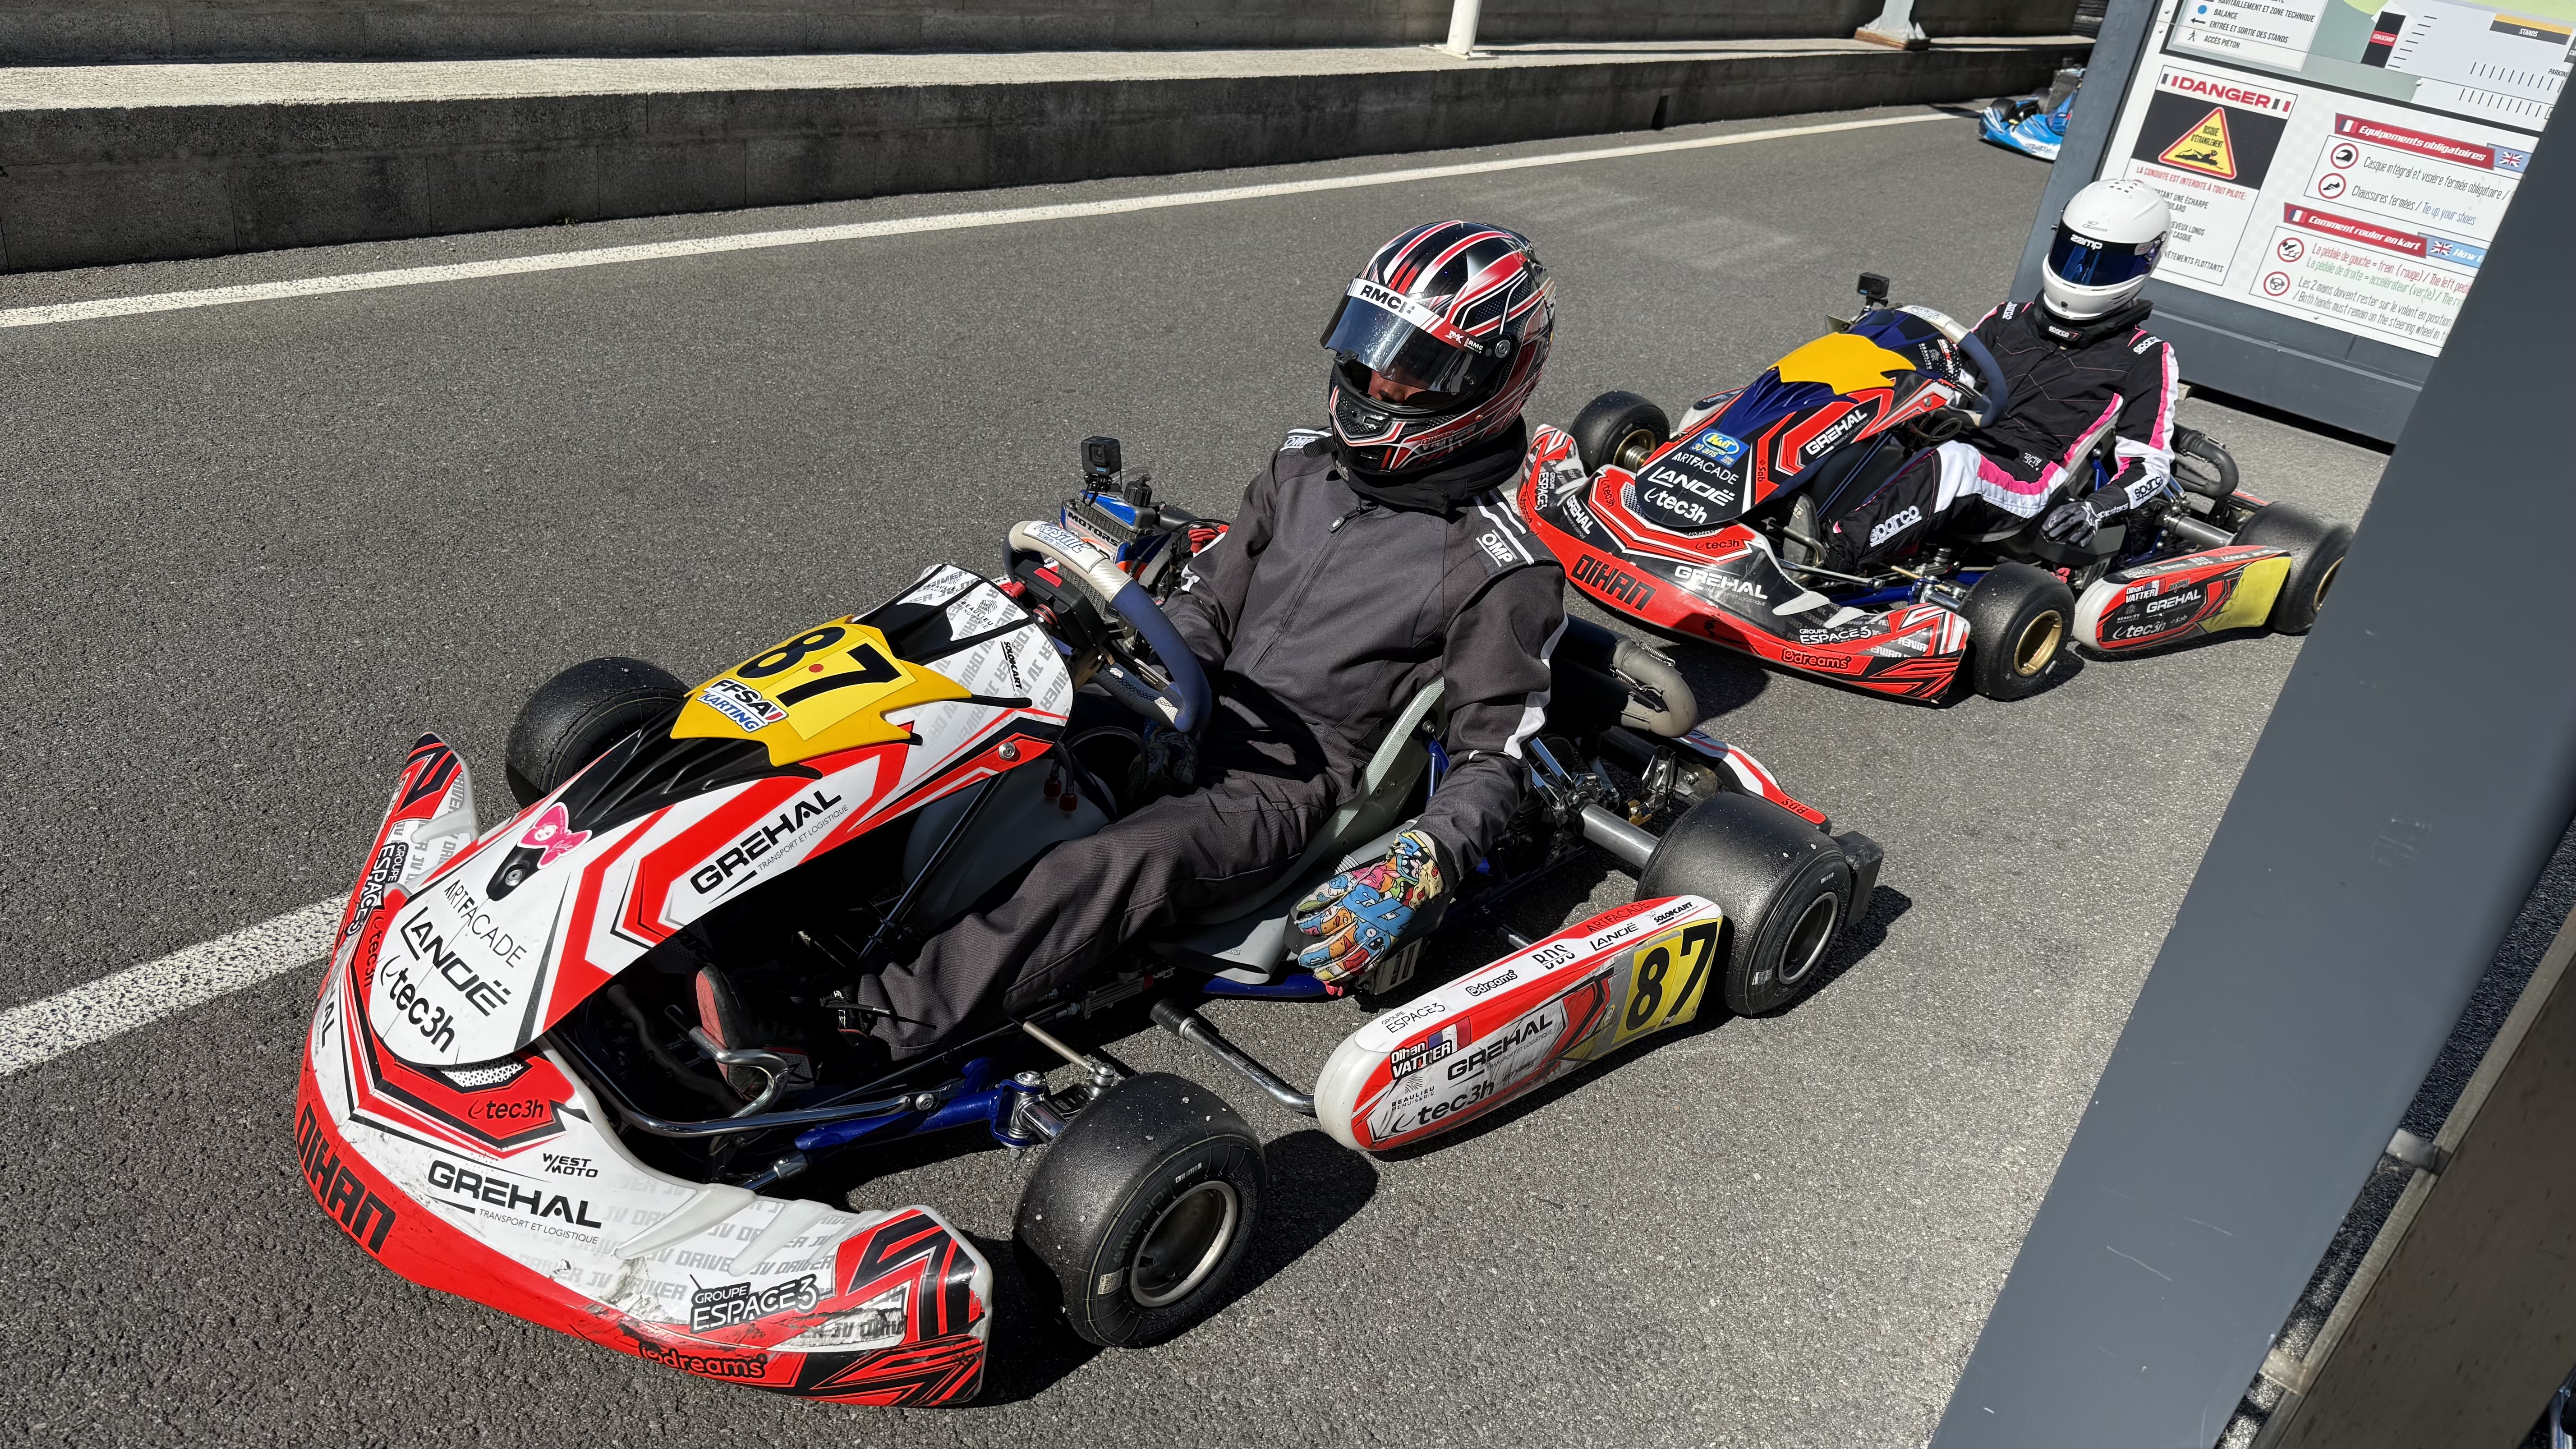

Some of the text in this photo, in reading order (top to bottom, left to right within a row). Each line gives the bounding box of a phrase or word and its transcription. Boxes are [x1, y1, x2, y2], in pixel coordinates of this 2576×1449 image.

[2214, 9, 2238, 20] BALANCE
[2270, 7, 2285, 16] ZONE
[2284, 10, 2316, 22] TECHNIQUE
[2209, 21, 2229, 31] ENTRÉE
[2237, 27, 2257, 37] SORTIE
[2258, 31, 2267, 39] DES
[2268, 33, 2289, 43] STANDS
[2222, 38, 2241, 49] PIÉTON
[2519, 28, 2539, 37] STANDS
[2178, 77, 2272, 109] DANGER
[2203, 125, 2220, 137] RISQUE
[2359, 126, 2487, 161] Equipements obligatoires
[2144, 168, 2169, 181] CONDUITE
[2170, 174, 2180, 183] EST
[2180, 176, 2208, 190] INTERDITE
[2213, 185, 2226, 194] TOUT
[2364, 157, 2386, 173] Casque
[2387, 162, 2413, 178] intégral
[2413, 170, 2422, 180] et
[2444, 175, 2467, 191] fermée
[2468, 181, 2502, 200] obligatoire
[2173, 193, 2209, 209] UNE ÉCHARPE
[2352, 185, 2389, 204] Chaussures
[2388, 194, 2415, 211] fermées
[2430, 206, 2440, 217] up
[2440, 209, 2457, 221] your
[2458, 213, 2476, 225] shoes
[2070, 234, 2103, 250] zamp
[2173, 232, 2193, 242] CASQUE
[2189, 225, 2205, 236] LONGS
[2308, 215, 2355, 235] Comment
[2354, 228, 2385, 241] rouler
[2194, 259, 2224, 272] FLOTTANTS
[2312, 243, 2321, 255] La
[2320, 246, 2343, 261] pédale
[2342, 251, 2351, 262] de
[2349, 255, 2372, 269] gauche
[2430, 273, 2441, 285] The
[2441, 277, 2455, 289] left
[2453, 248, 2476, 261] How
[2306, 257, 2315, 268] La
[2315, 259, 2337, 275] pédale
[2337, 265, 2345, 275] de
[2442, 292, 2454, 305] The
[2298, 276, 2310, 289] Les
[2310, 280, 2317, 290] 2
[2317, 283, 2334, 295] mains
[2333, 285, 2359, 303] doivent
[2357, 293, 2380, 308] rester
[2379, 301, 2391, 310] sur
[2390, 300, 2398, 313] le
[2398, 304, 2418, 320] volant
[2418, 310, 2426, 321] en
[2298, 291, 2314, 304] Both
[2314, 295, 2332, 310] hands
[2332, 301, 2348, 314] must
[2347, 307, 2369, 319] remain
[2368, 313, 2378, 322] on
[2377, 313, 2389, 325] the
[2388, 315, 2418, 335] steering
[2048, 326, 2070, 338] sparco
[1691, 443, 1701, 451] 30
[1805, 409, 1868, 455] GREHAL
[1671, 452, 1739, 485] ARTFACADE
[1534, 472, 1549, 511] ESPACE3
[1068, 511, 1119, 547] MOTORS
[1566, 494, 1593, 535] GREHAL
[1869, 506, 1921, 544] sparco
[1481, 532, 1514, 564] OMP
[1705, 539, 1740, 550] tec3h
[1674, 566, 1768, 600] GREHAL
[2125, 589, 2155, 603] VATTIER
[961, 601, 994, 626] BEAULIEU
[2146, 589, 2201, 613] GREHAL
[1799, 626, 1872, 644] ESPACE3
[737, 626, 902, 708] 87
[1004, 641, 1022, 690] SOLOKART
[701, 693, 761, 730] KARTING
[711, 679, 772, 715] FFSA
[690, 791, 842, 894] GREHAL
[758, 805, 849, 871] TRANSPORT ET LOGISTIQUE
[388, 845, 406, 882] GROUPE
[444, 879, 527, 969] ARTFACADE
[1586, 901, 1651, 934] ARTFACADE
[1654, 902, 1693, 923] SOLOKART
[1626, 921, 1719, 1031] 87
[1381, 1010, 1406, 1026] GROUPE
[1386, 1002, 1446, 1034] ESPACE3
[1390, 1042, 1426, 1064] Oihan
[1393, 1042, 1453, 1080] VATTIER
[1447, 1010, 1553, 1081] GREHAL
[486, 1100, 544, 1119] tec3h
[1391, 1086, 1435, 1107] BEAULIEU
[1419, 1081, 1495, 1127] tec3h
[543, 1153, 592, 1165] WEST
[550, 1165, 599, 1178] MOTO
[428, 1160, 602, 1229] GREHAL
[479, 1208, 599, 1245] TRANSPORT ET LOGISTIQUE
[694, 1277, 818, 1331] ESPACE3
[695, 1285, 748, 1304] GROUPE
